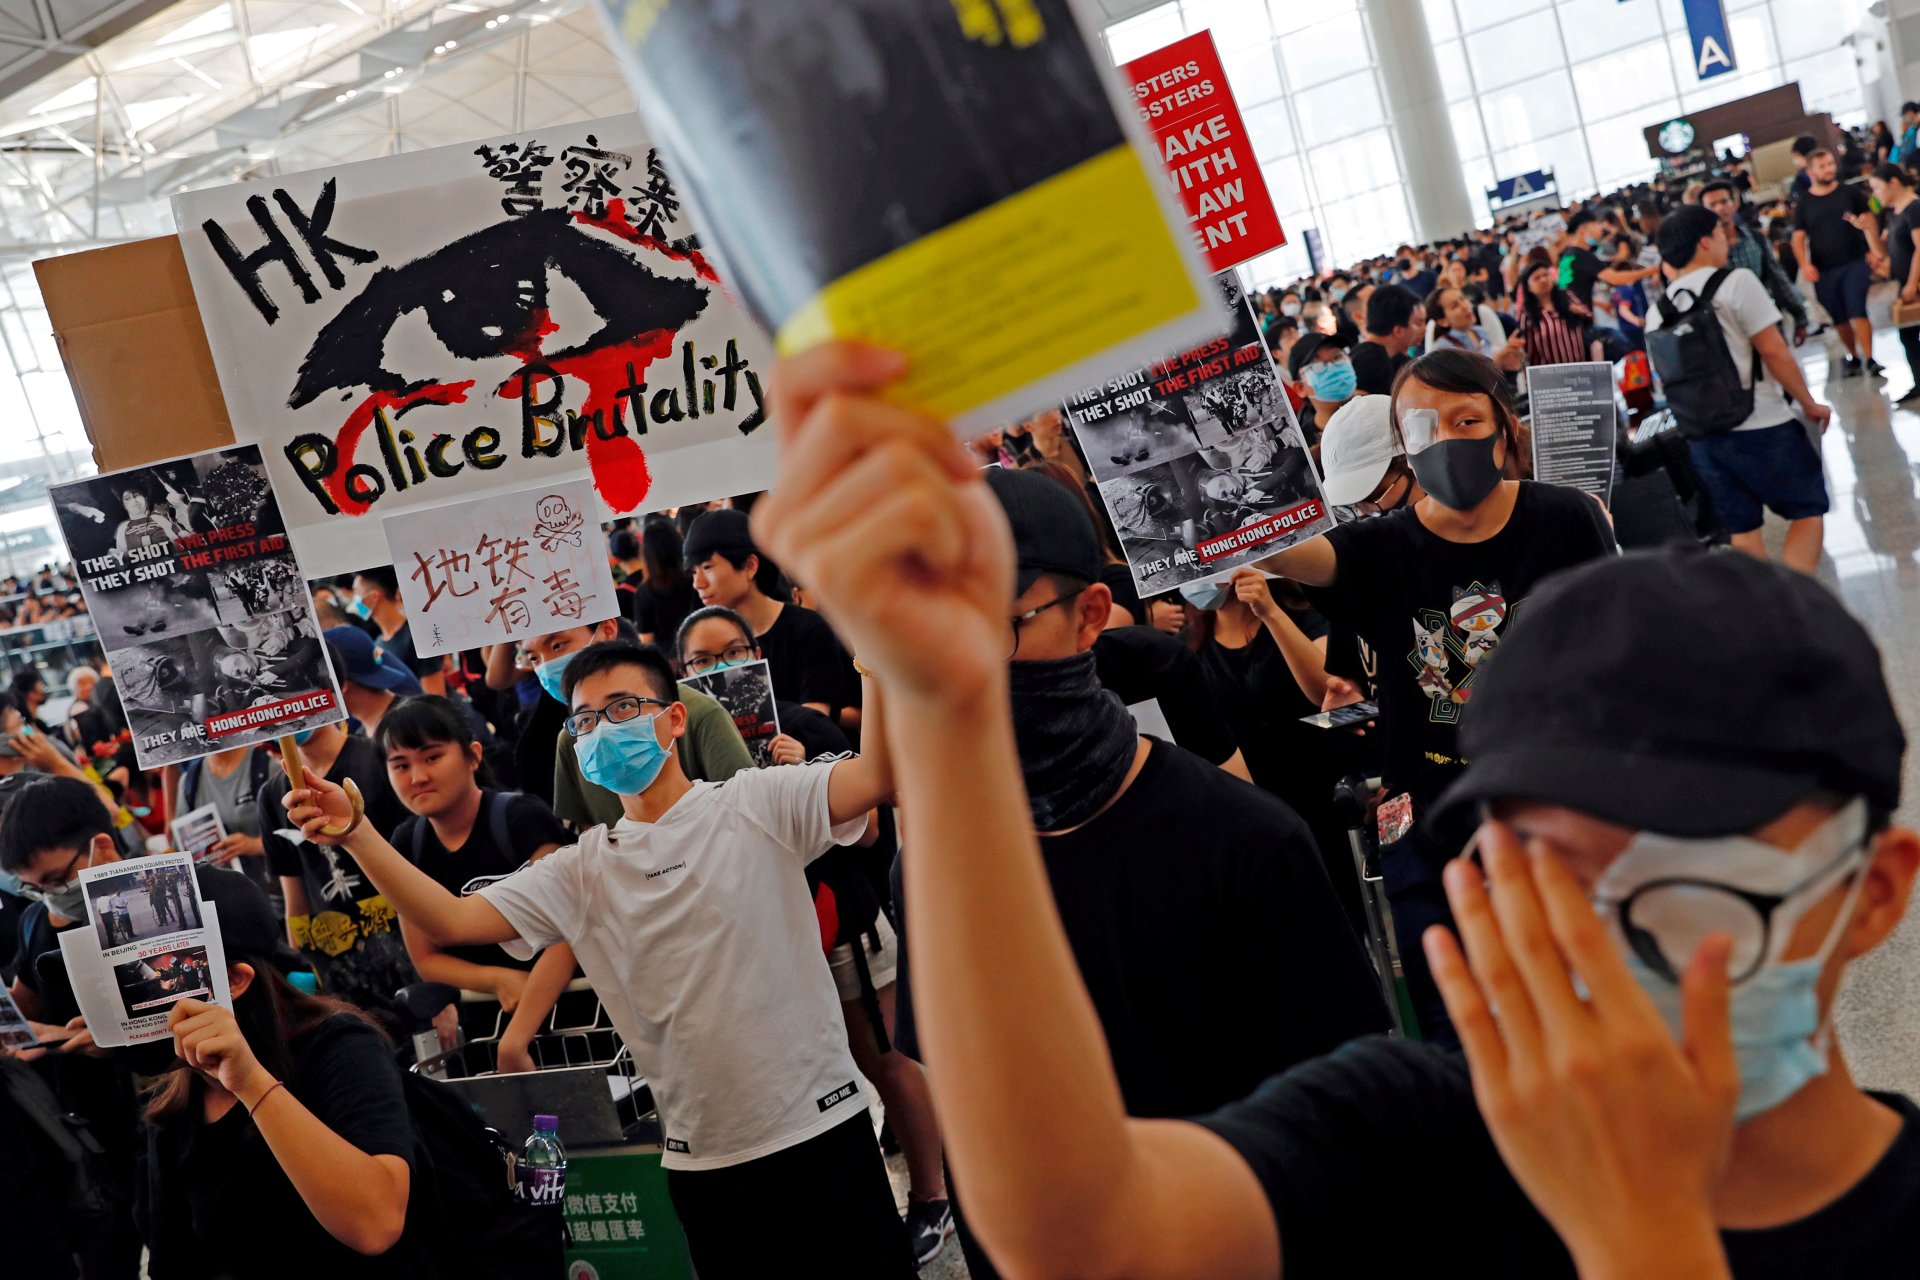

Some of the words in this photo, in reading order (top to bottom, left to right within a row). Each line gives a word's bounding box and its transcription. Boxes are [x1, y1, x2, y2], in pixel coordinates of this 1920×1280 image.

[1698, 35, 1731, 75] A
[1512, 175, 1535, 198] A
[202, 177, 379, 327] HK
[1069, 384, 1106, 407] THEY
[1110, 368, 1145, 394] SHOT
[1148, 359, 1180, 378] THE
[1181, 336, 1230, 367] PRESS
[1075, 401, 1113, 424] THEY
[1114, 386, 1152, 412] SHOT
[1155, 374, 1188, 396] THE
[1188, 356, 1230, 387] FIRST
[1234, 345, 1260, 367] AID
[284, 406, 507, 515] Police
[520, 338, 769, 459] Brutality
[81, 551, 127, 574] THEY
[129, 541, 170, 563] SHOT
[175, 534, 207, 551] THE
[207, 523, 256, 545] PRESS
[1138, 557, 1171, 577] THEY
[1173, 549, 1199, 566] ARE
[1201, 539, 1238, 558] HONG
[1238, 522, 1273, 546] KONG
[1273, 504, 1318, 533] POLICE
[88, 570, 131, 593] THEY
[134, 560, 176, 583] SHOT
[180, 552, 213, 570] THE
[213, 541, 258, 563] FIRST
[260, 535, 286, 552] AID
[411, 533, 535, 613] 地铁
[485, 568, 597, 635] 有毒
[141, 732, 178, 750] THEY
[180, 724, 207, 741] ARE
[210, 716, 247, 733] HONG
[247, 706, 283, 725] KONG
[284, 694, 330, 716] POLICE
[109, 864, 144, 876] TIANANMEN
[144, 861, 165, 869] SQUARE
[165, 858, 185, 866] PROTEST
[111, 945, 138, 956] BEIJING
[148, 944, 172, 955] YEARS
[173, 941, 190, 950] LATER
[129, 1017, 147, 1026] HONG
[149, 1013, 168, 1023] KONG
[148, 998, 171, 1007] ACTUALLY
[129, 1032, 151, 1040] PLEASE
[151, 1028, 167, 1037] DON'T
[824, 1093, 839, 1107] EXO
[838, 1086, 851, 1098] ME
[562, 1192, 638, 1216] 微信支付
[567, 1218, 646, 1242] 超優匯率
